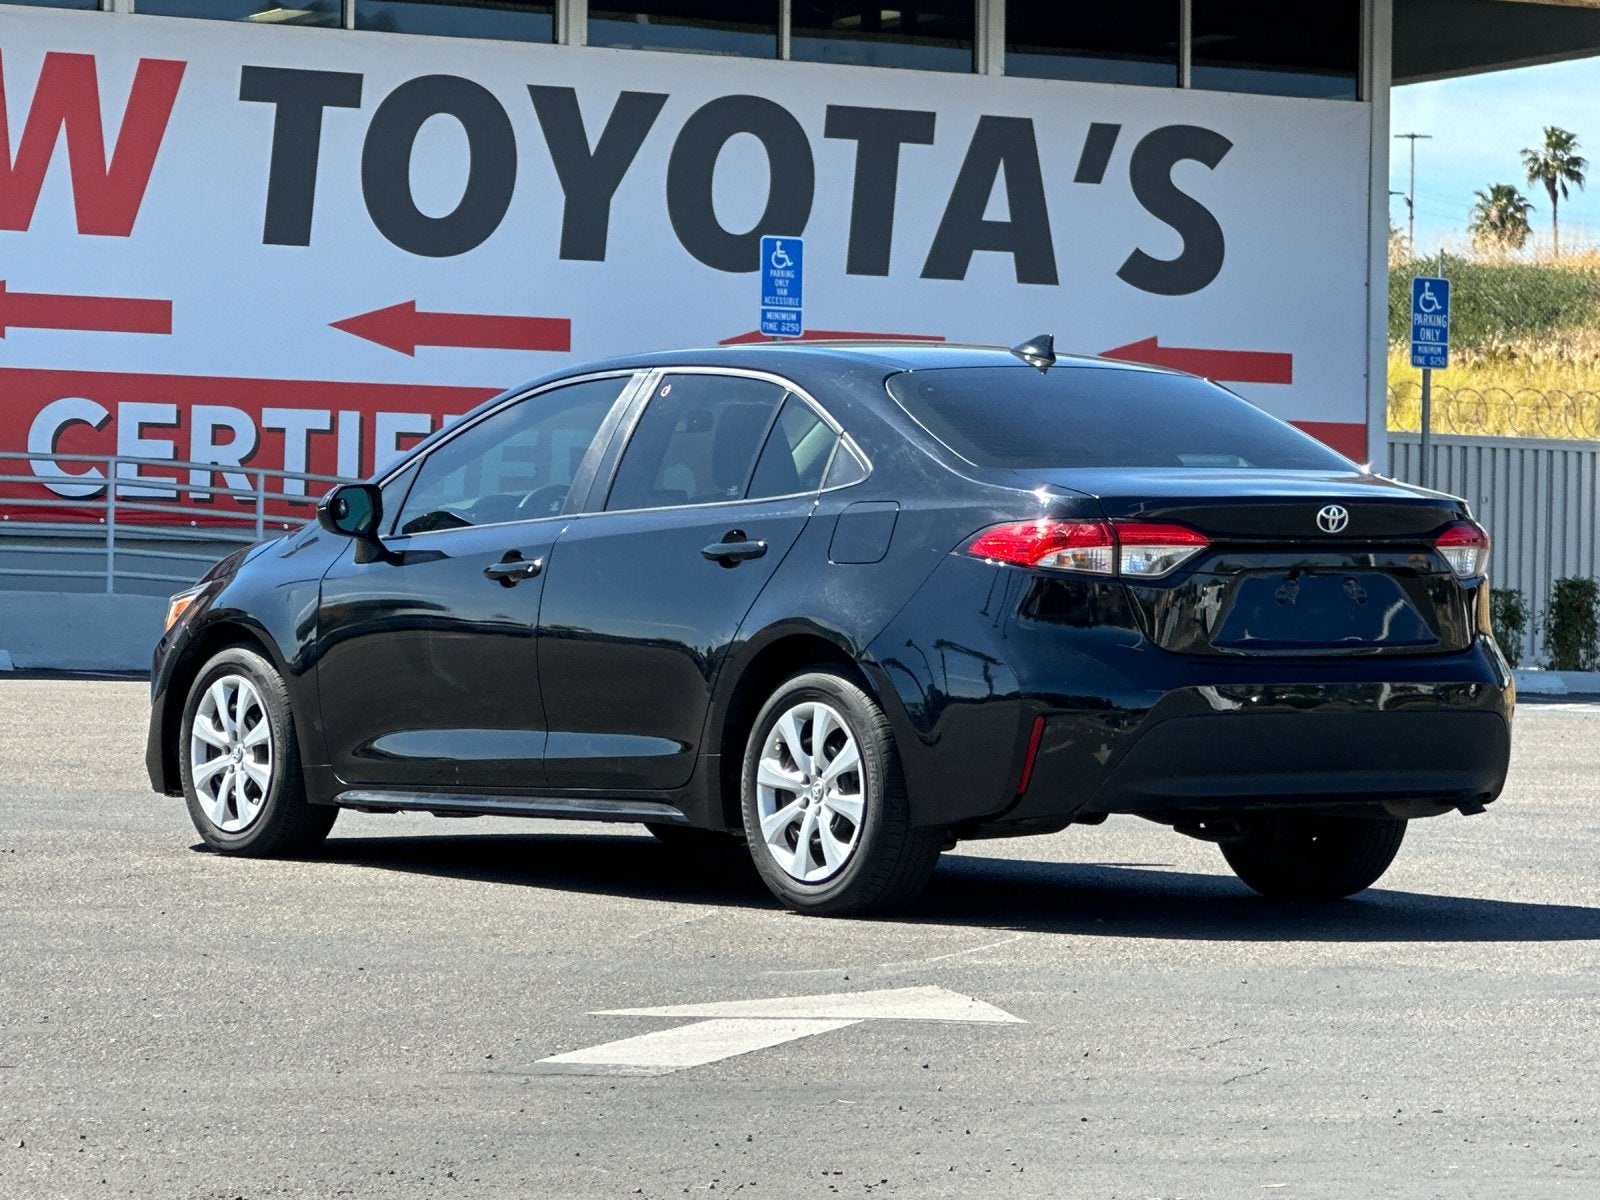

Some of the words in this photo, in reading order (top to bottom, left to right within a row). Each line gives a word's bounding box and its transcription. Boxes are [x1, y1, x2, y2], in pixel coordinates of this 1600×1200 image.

[239, 65, 1234, 296] TOYOTA'S
[770, 269, 795, 279] PARKING
[775, 279, 790, 288] ONLY
[777, 288, 788, 296] VAN
[764, 296, 800, 306] ACCESSIBLE
[766, 311, 797, 321] MINIMUM
[1413, 313, 1447, 328] PARKING
[762, 321, 778, 331] FINE
[781, 322, 800, 332] $250
[1420, 327, 1441, 341] ONLY
[1417, 345, 1442, 355] MINIMUM
[1413, 355, 1426, 365] FINE
[1429, 356, 1446, 366] $250
